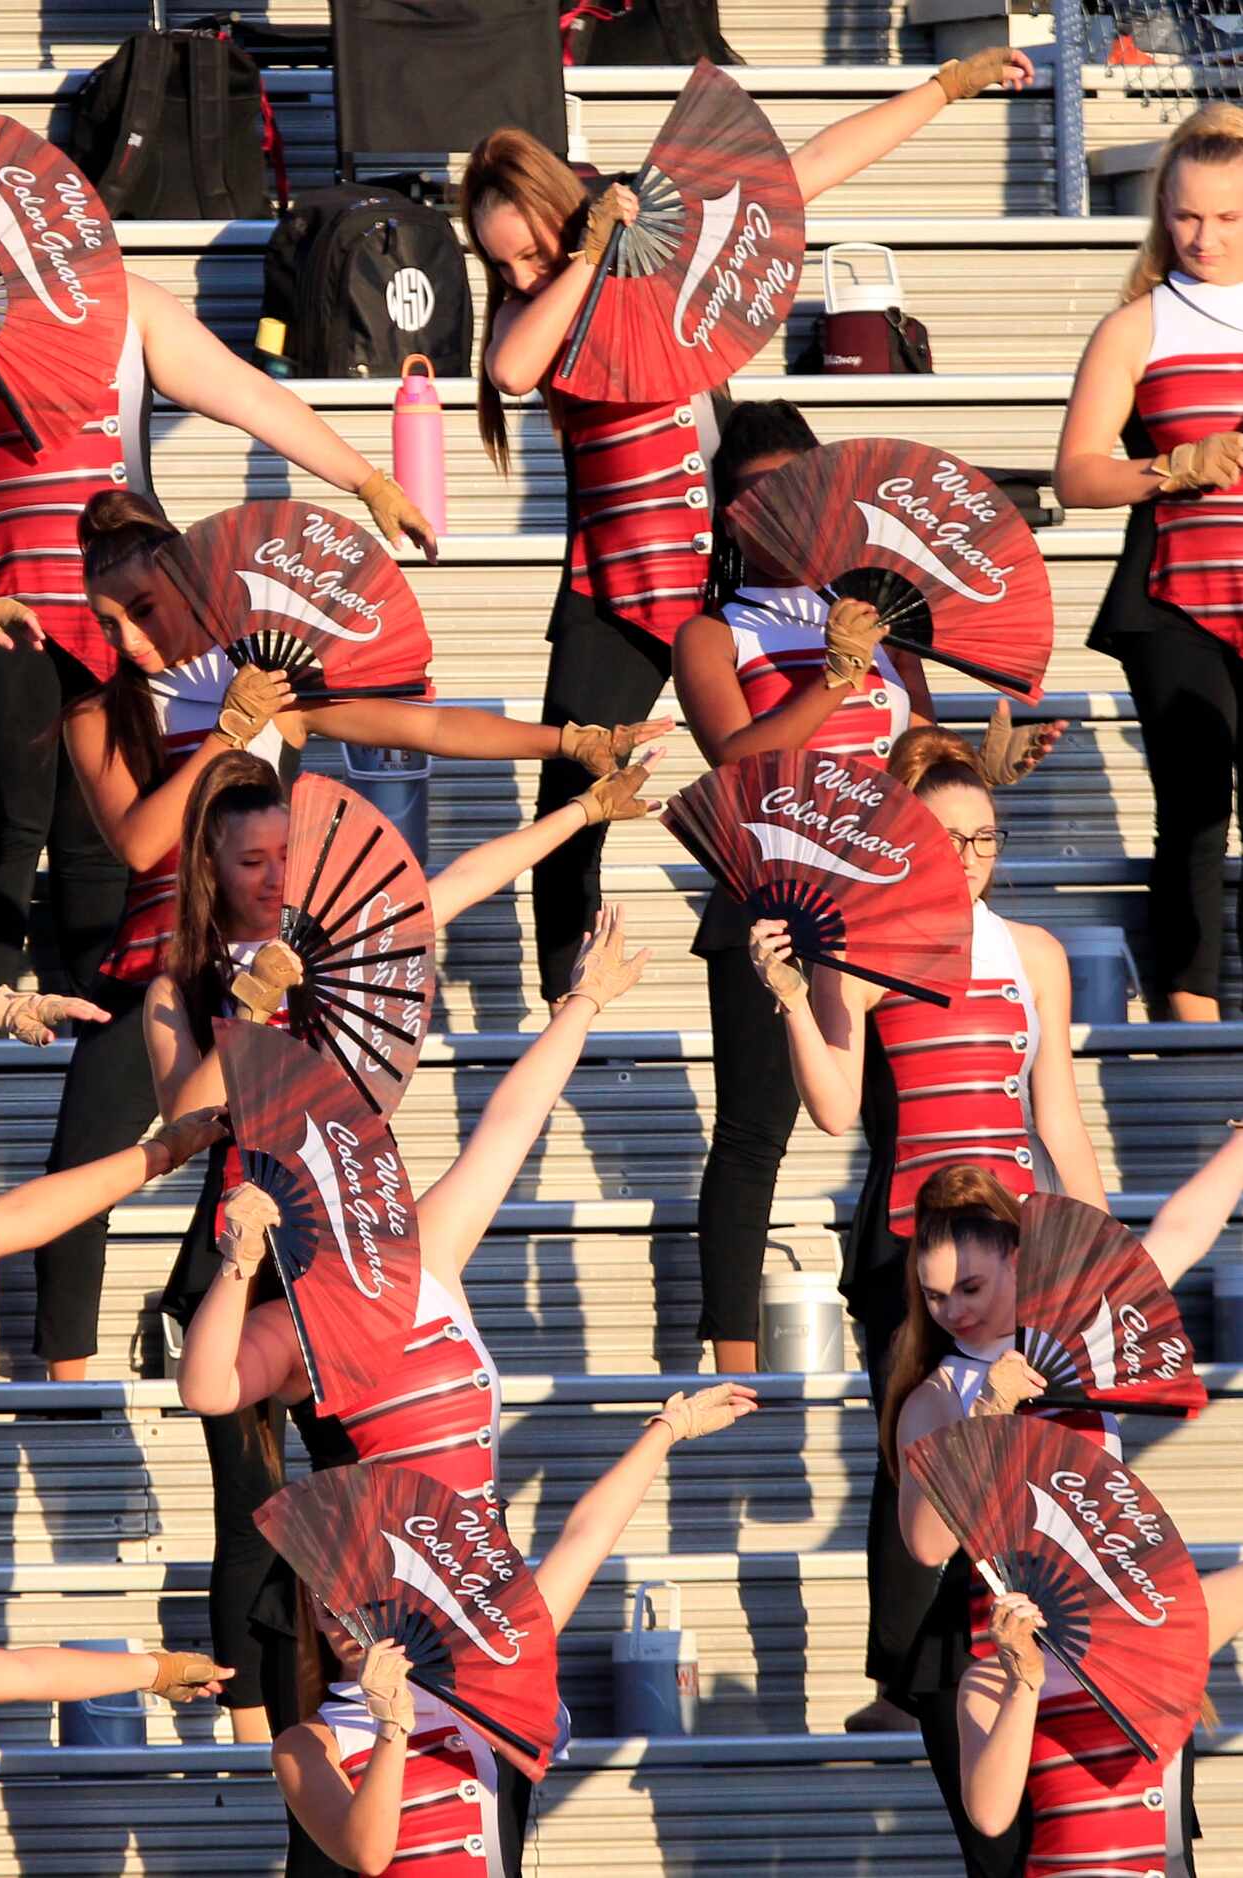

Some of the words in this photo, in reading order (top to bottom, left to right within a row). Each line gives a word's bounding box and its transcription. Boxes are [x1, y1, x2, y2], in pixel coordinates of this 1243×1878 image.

[55, 173, 102, 249] Wylie
[729, 202, 772, 270] Color
[32, 231, 100, 309] Guard
[746, 258, 795, 326] Wylie
[694, 265, 741, 352] Guard
[932, 460, 996, 522] Wylie
[301, 513, 365, 564] Wylie
[877, 477, 939, 529] Color
[930, 522, 1015, 584] Guard
[254, 538, 314, 584] Color
[310, 570, 384, 620] Guard
[814, 760, 884, 807] Wylie
[760, 786, 830, 831] Color
[826, 814, 915, 863] Guard
[326, 1120, 363, 1196] Color
[373, 1151, 407, 1237] Wylie
[344, 1198, 395, 1289] Guard
[455, 1509, 514, 1581] Wylie
[1050, 1471, 1106, 1536] Color
[1097, 1533, 1176, 1608] Guard
[1105, 1470, 1163, 1545] Wylie
[404, 1515, 462, 1576] Color
[455, 1573, 529, 1645] Guard
